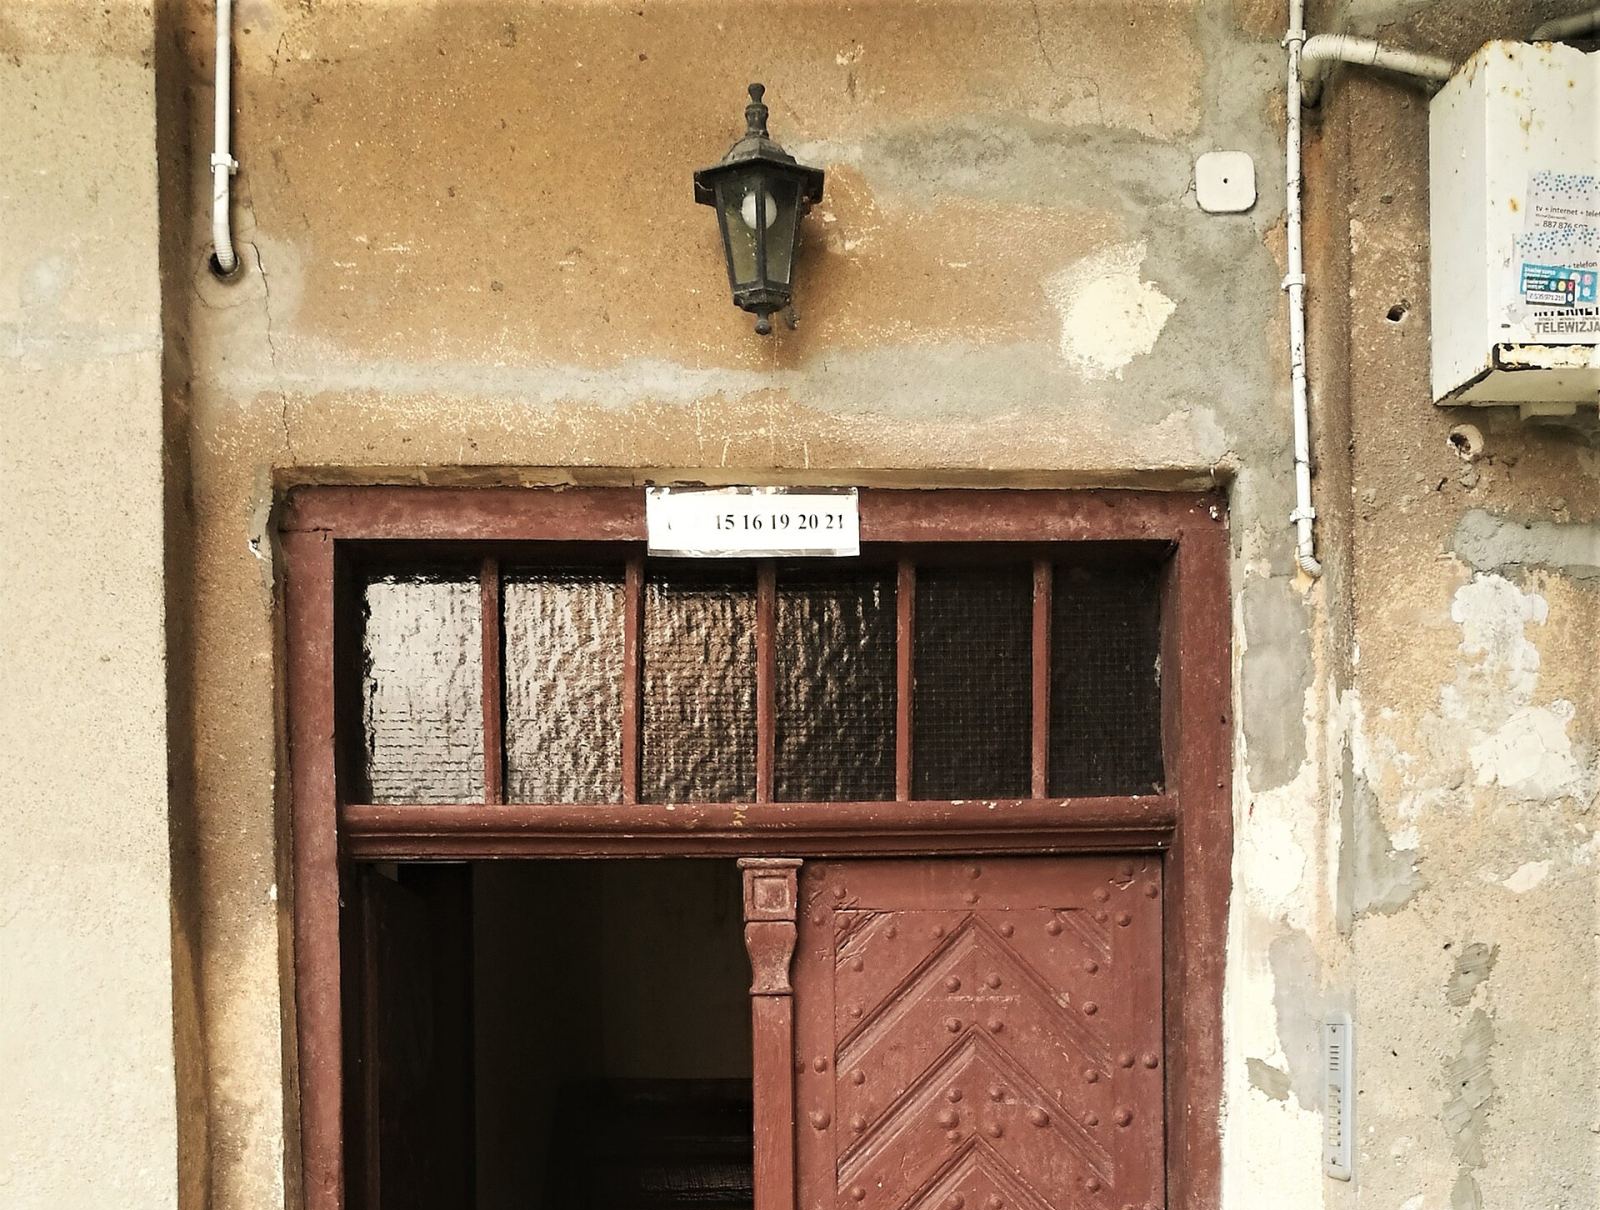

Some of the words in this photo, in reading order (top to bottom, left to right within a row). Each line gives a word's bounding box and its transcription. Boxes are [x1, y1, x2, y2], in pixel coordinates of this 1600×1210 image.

[1550, 205, 1578, 216] internet
[1542, 220, 1557, 229] 887
[1534, 321, 1600, 333] TELEWIZJA
[715, 514, 736, 531] 15
[743, 514, 763, 531] 16
[771, 514, 790, 531] 19
[797, 513, 819, 531] 20
[825, 513, 845, 531] 21
